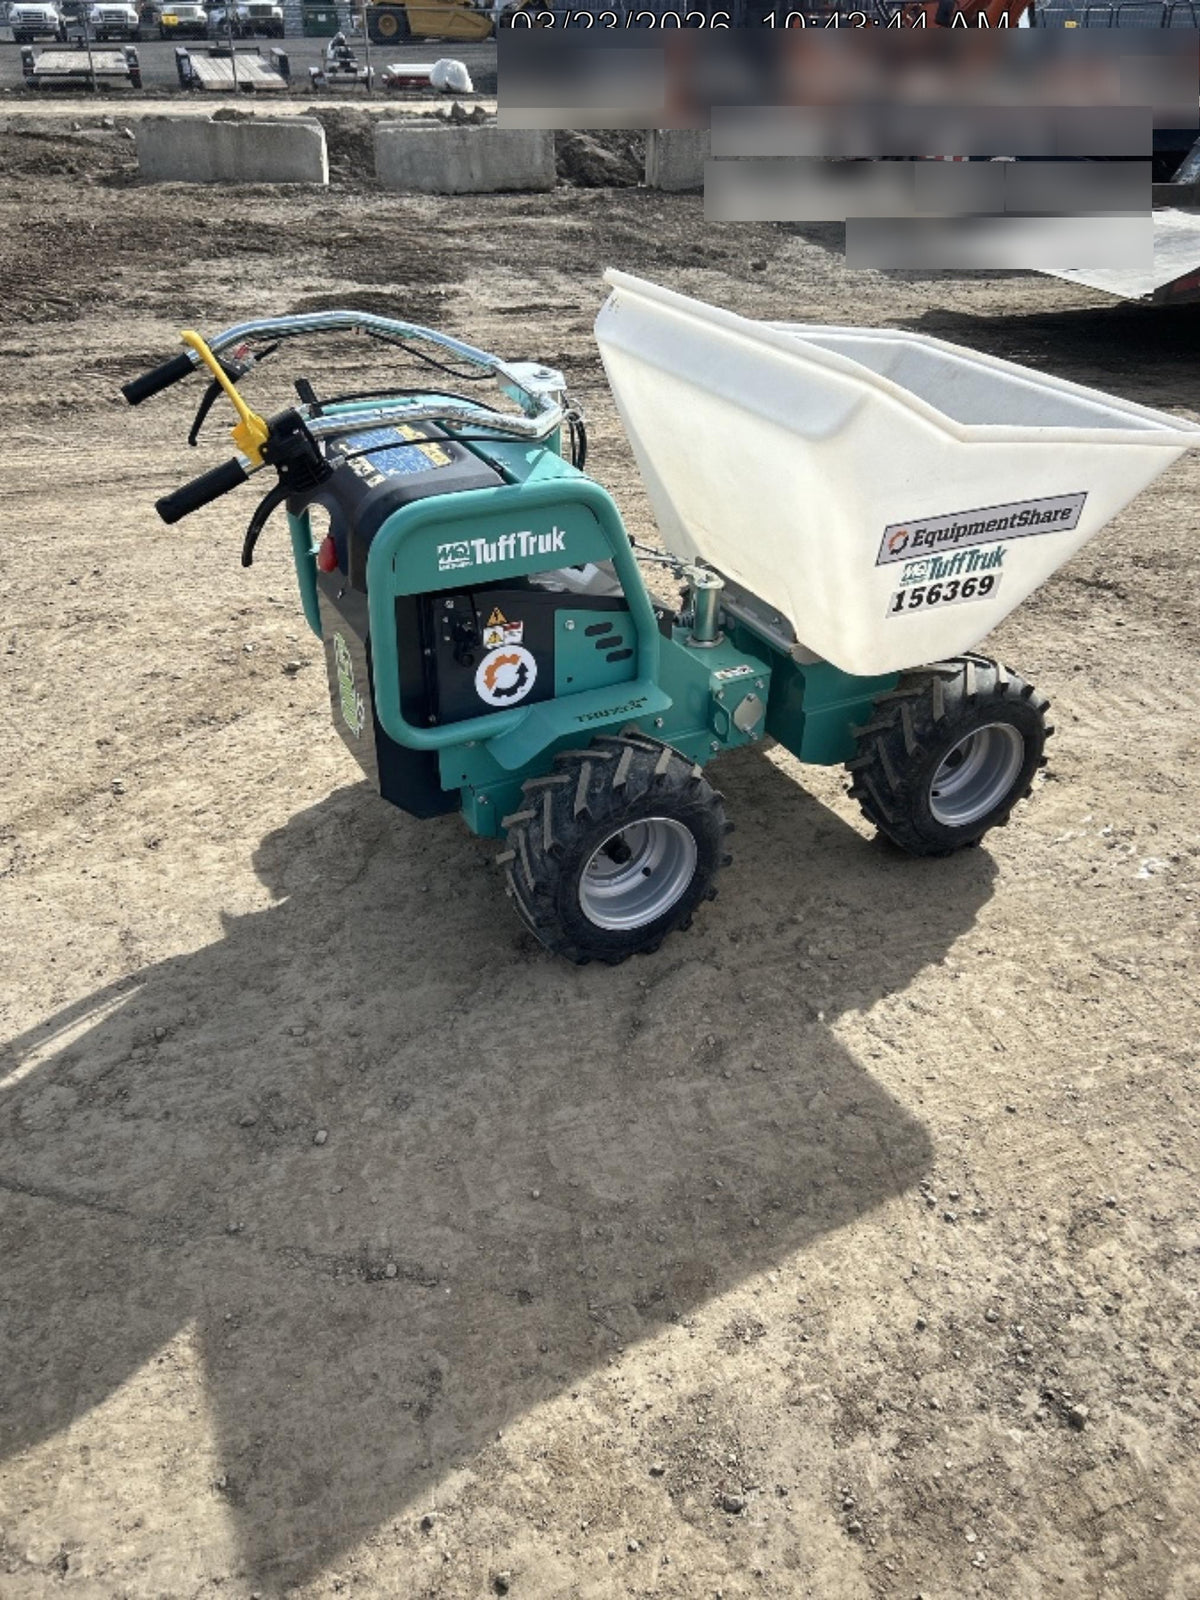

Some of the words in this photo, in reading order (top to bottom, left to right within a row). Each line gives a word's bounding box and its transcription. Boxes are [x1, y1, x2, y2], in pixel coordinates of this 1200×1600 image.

[471, 526, 567, 564] TuffTruk
[911, 506, 1073, 549] EquipmentShare
[929, 545, 1008, 580] TuffTruk
[892, 574, 995, 612] 156369
